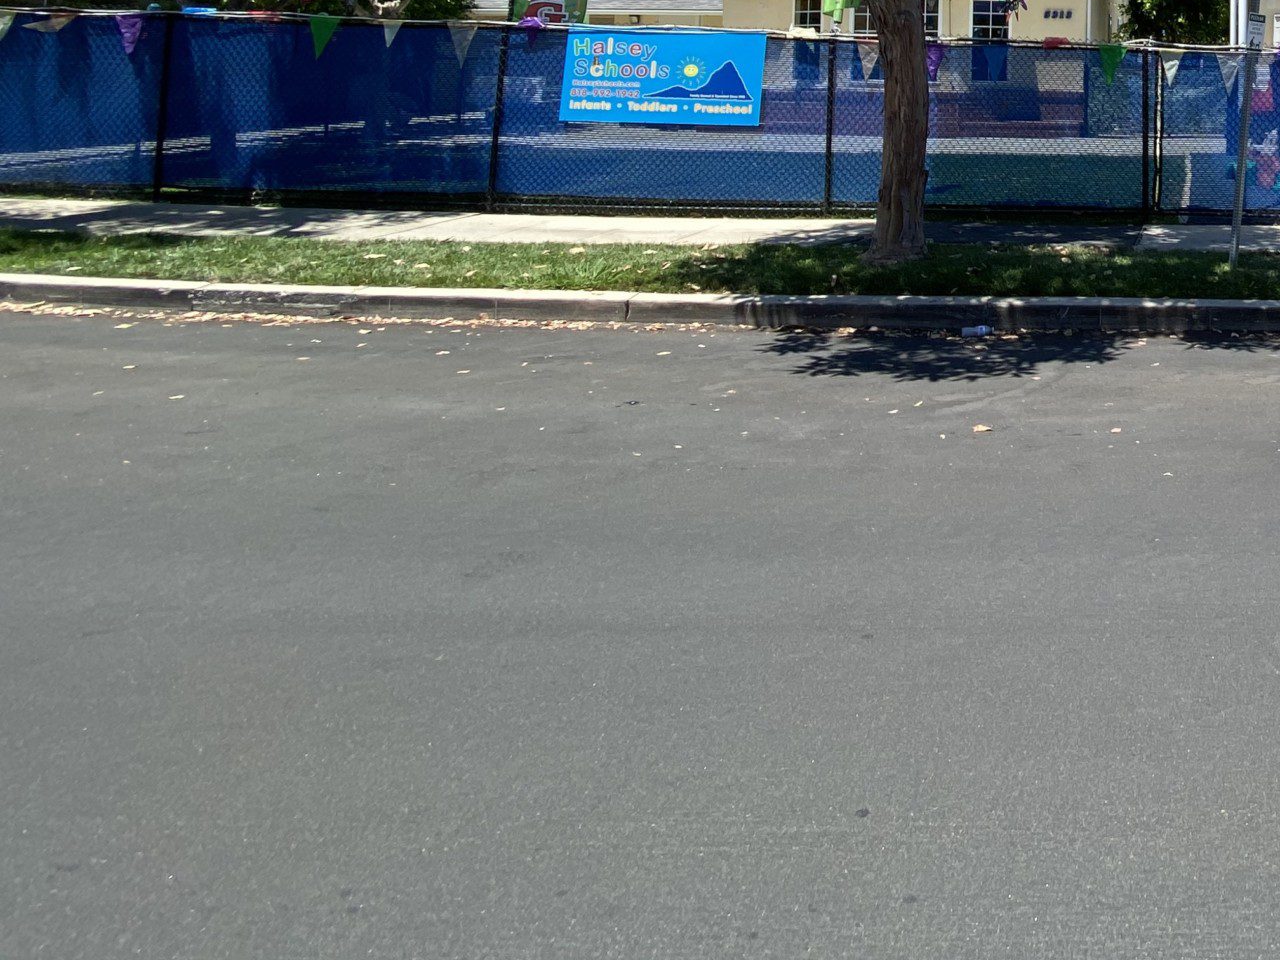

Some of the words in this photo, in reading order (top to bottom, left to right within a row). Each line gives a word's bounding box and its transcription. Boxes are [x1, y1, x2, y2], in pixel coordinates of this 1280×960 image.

[573, 37, 657, 61] Halsey
[573, 58, 670, 79] Schools
[570, 88, 640, 98] 818-992-1942
[569, 99, 612, 110] Infants
[627, 101, 678, 112] Toddlers
[693, 103, 752, 114] Preschool
